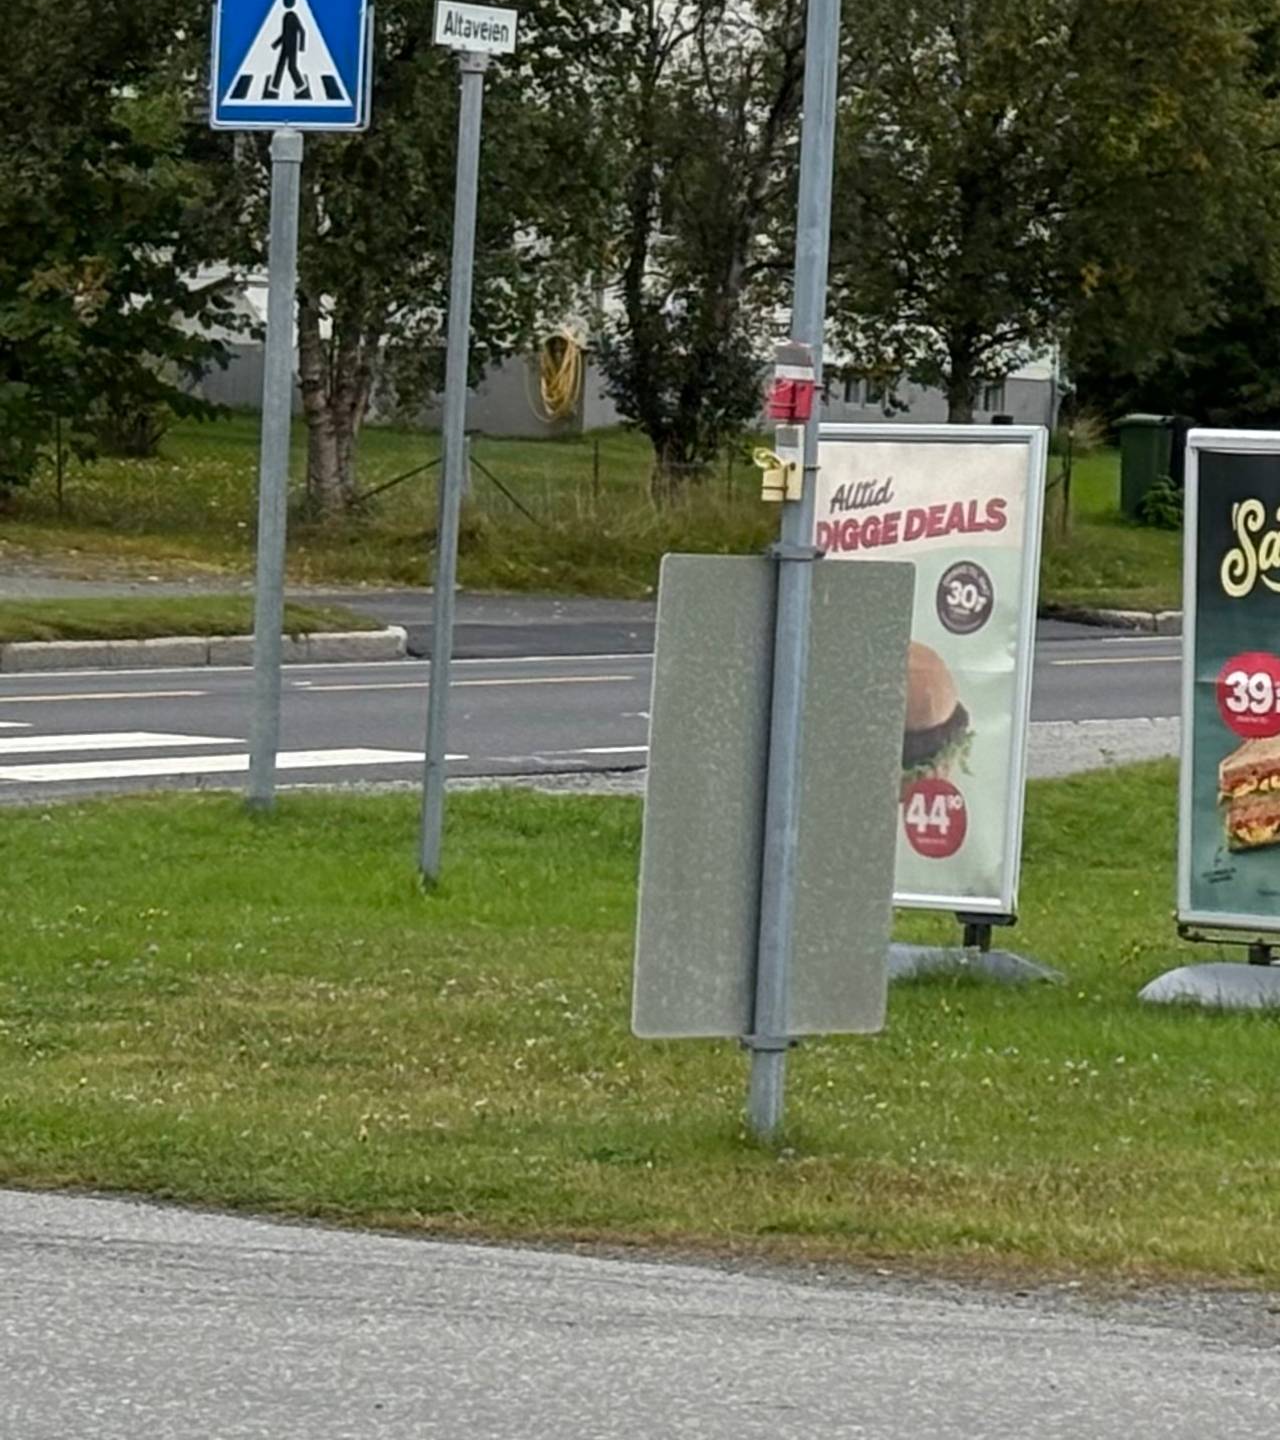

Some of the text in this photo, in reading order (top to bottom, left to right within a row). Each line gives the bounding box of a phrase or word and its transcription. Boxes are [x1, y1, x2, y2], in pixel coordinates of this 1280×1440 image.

[443, 10, 510, 43] Altaveien
[829, 477, 894, 514] Alltid
[816, 498, 1007, 552] DIGGE DEALS
